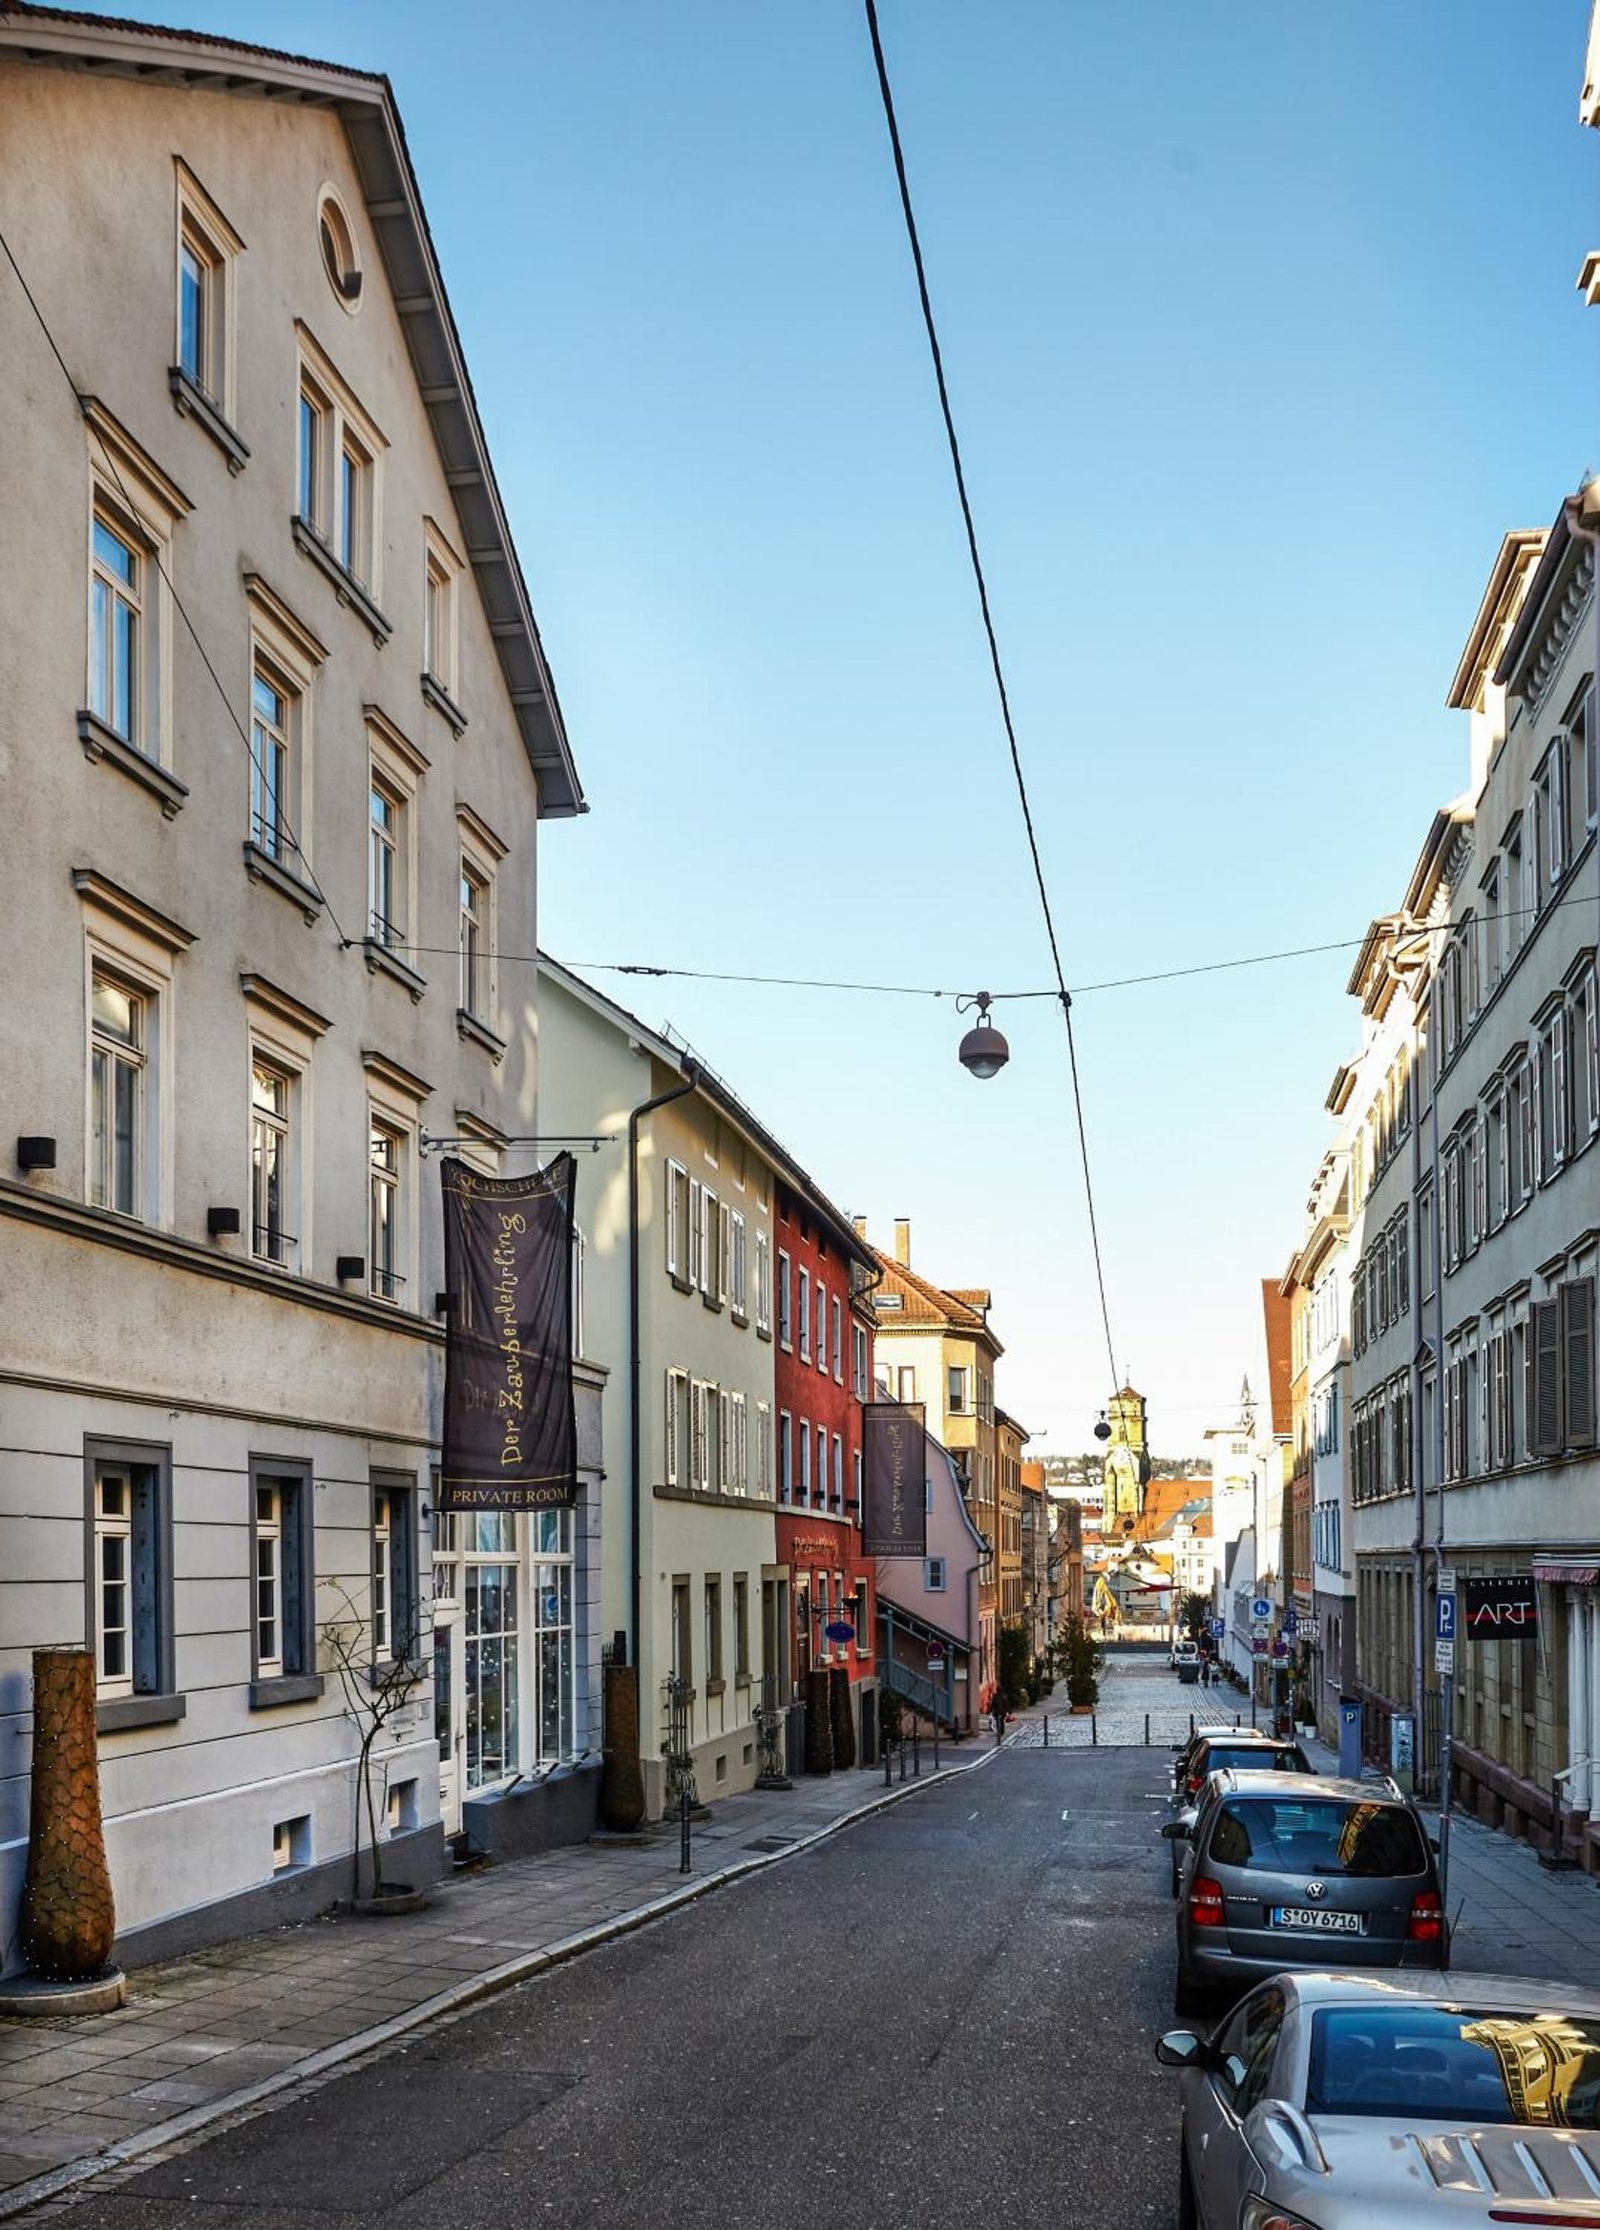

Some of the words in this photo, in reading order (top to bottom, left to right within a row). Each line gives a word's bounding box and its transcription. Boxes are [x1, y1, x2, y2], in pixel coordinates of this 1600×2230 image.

[494, 1213, 526, 1411] Zauberlehrling
[501, 1420, 524, 1467] Der
[452, 1490, 522, 1504] PRIVATE
[525, 1486, 568, 1503] ROOM
[1440, 1599, 1451, 1633] P
[1473, 1602, 1532, 1626] ART
[1346, 1711, 1354, 1723] P
[1282, 1909, 1292, 1923] S
[1300, 1911, 1320, 1925] OY
[1321, 1912, 1357, 1930] 6716
